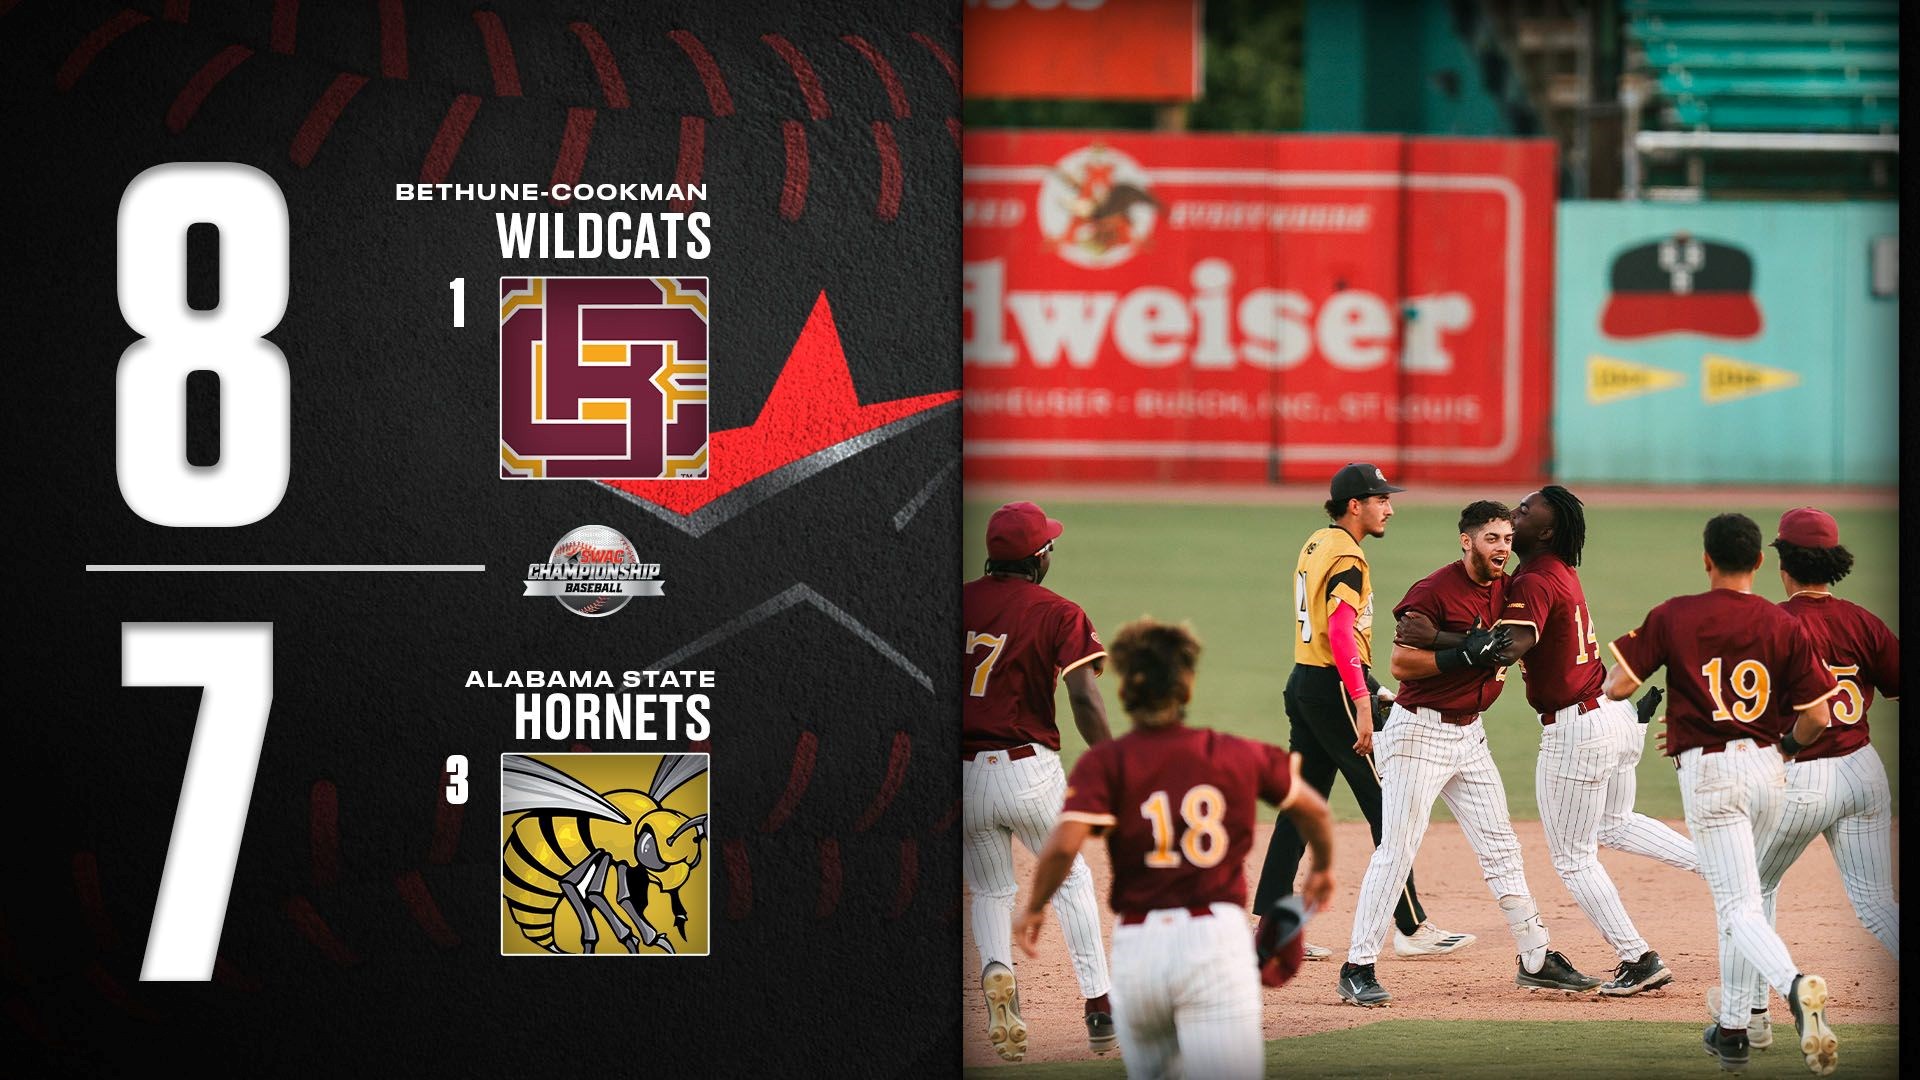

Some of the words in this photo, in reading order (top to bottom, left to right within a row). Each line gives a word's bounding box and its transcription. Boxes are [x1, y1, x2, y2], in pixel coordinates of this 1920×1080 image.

[966, 631, 1007, 697] 7
[1702, 657, 1771, 722] 19
[1822, 658, 1864, 727] 5
[1141, 785, 1229, 868] 18
